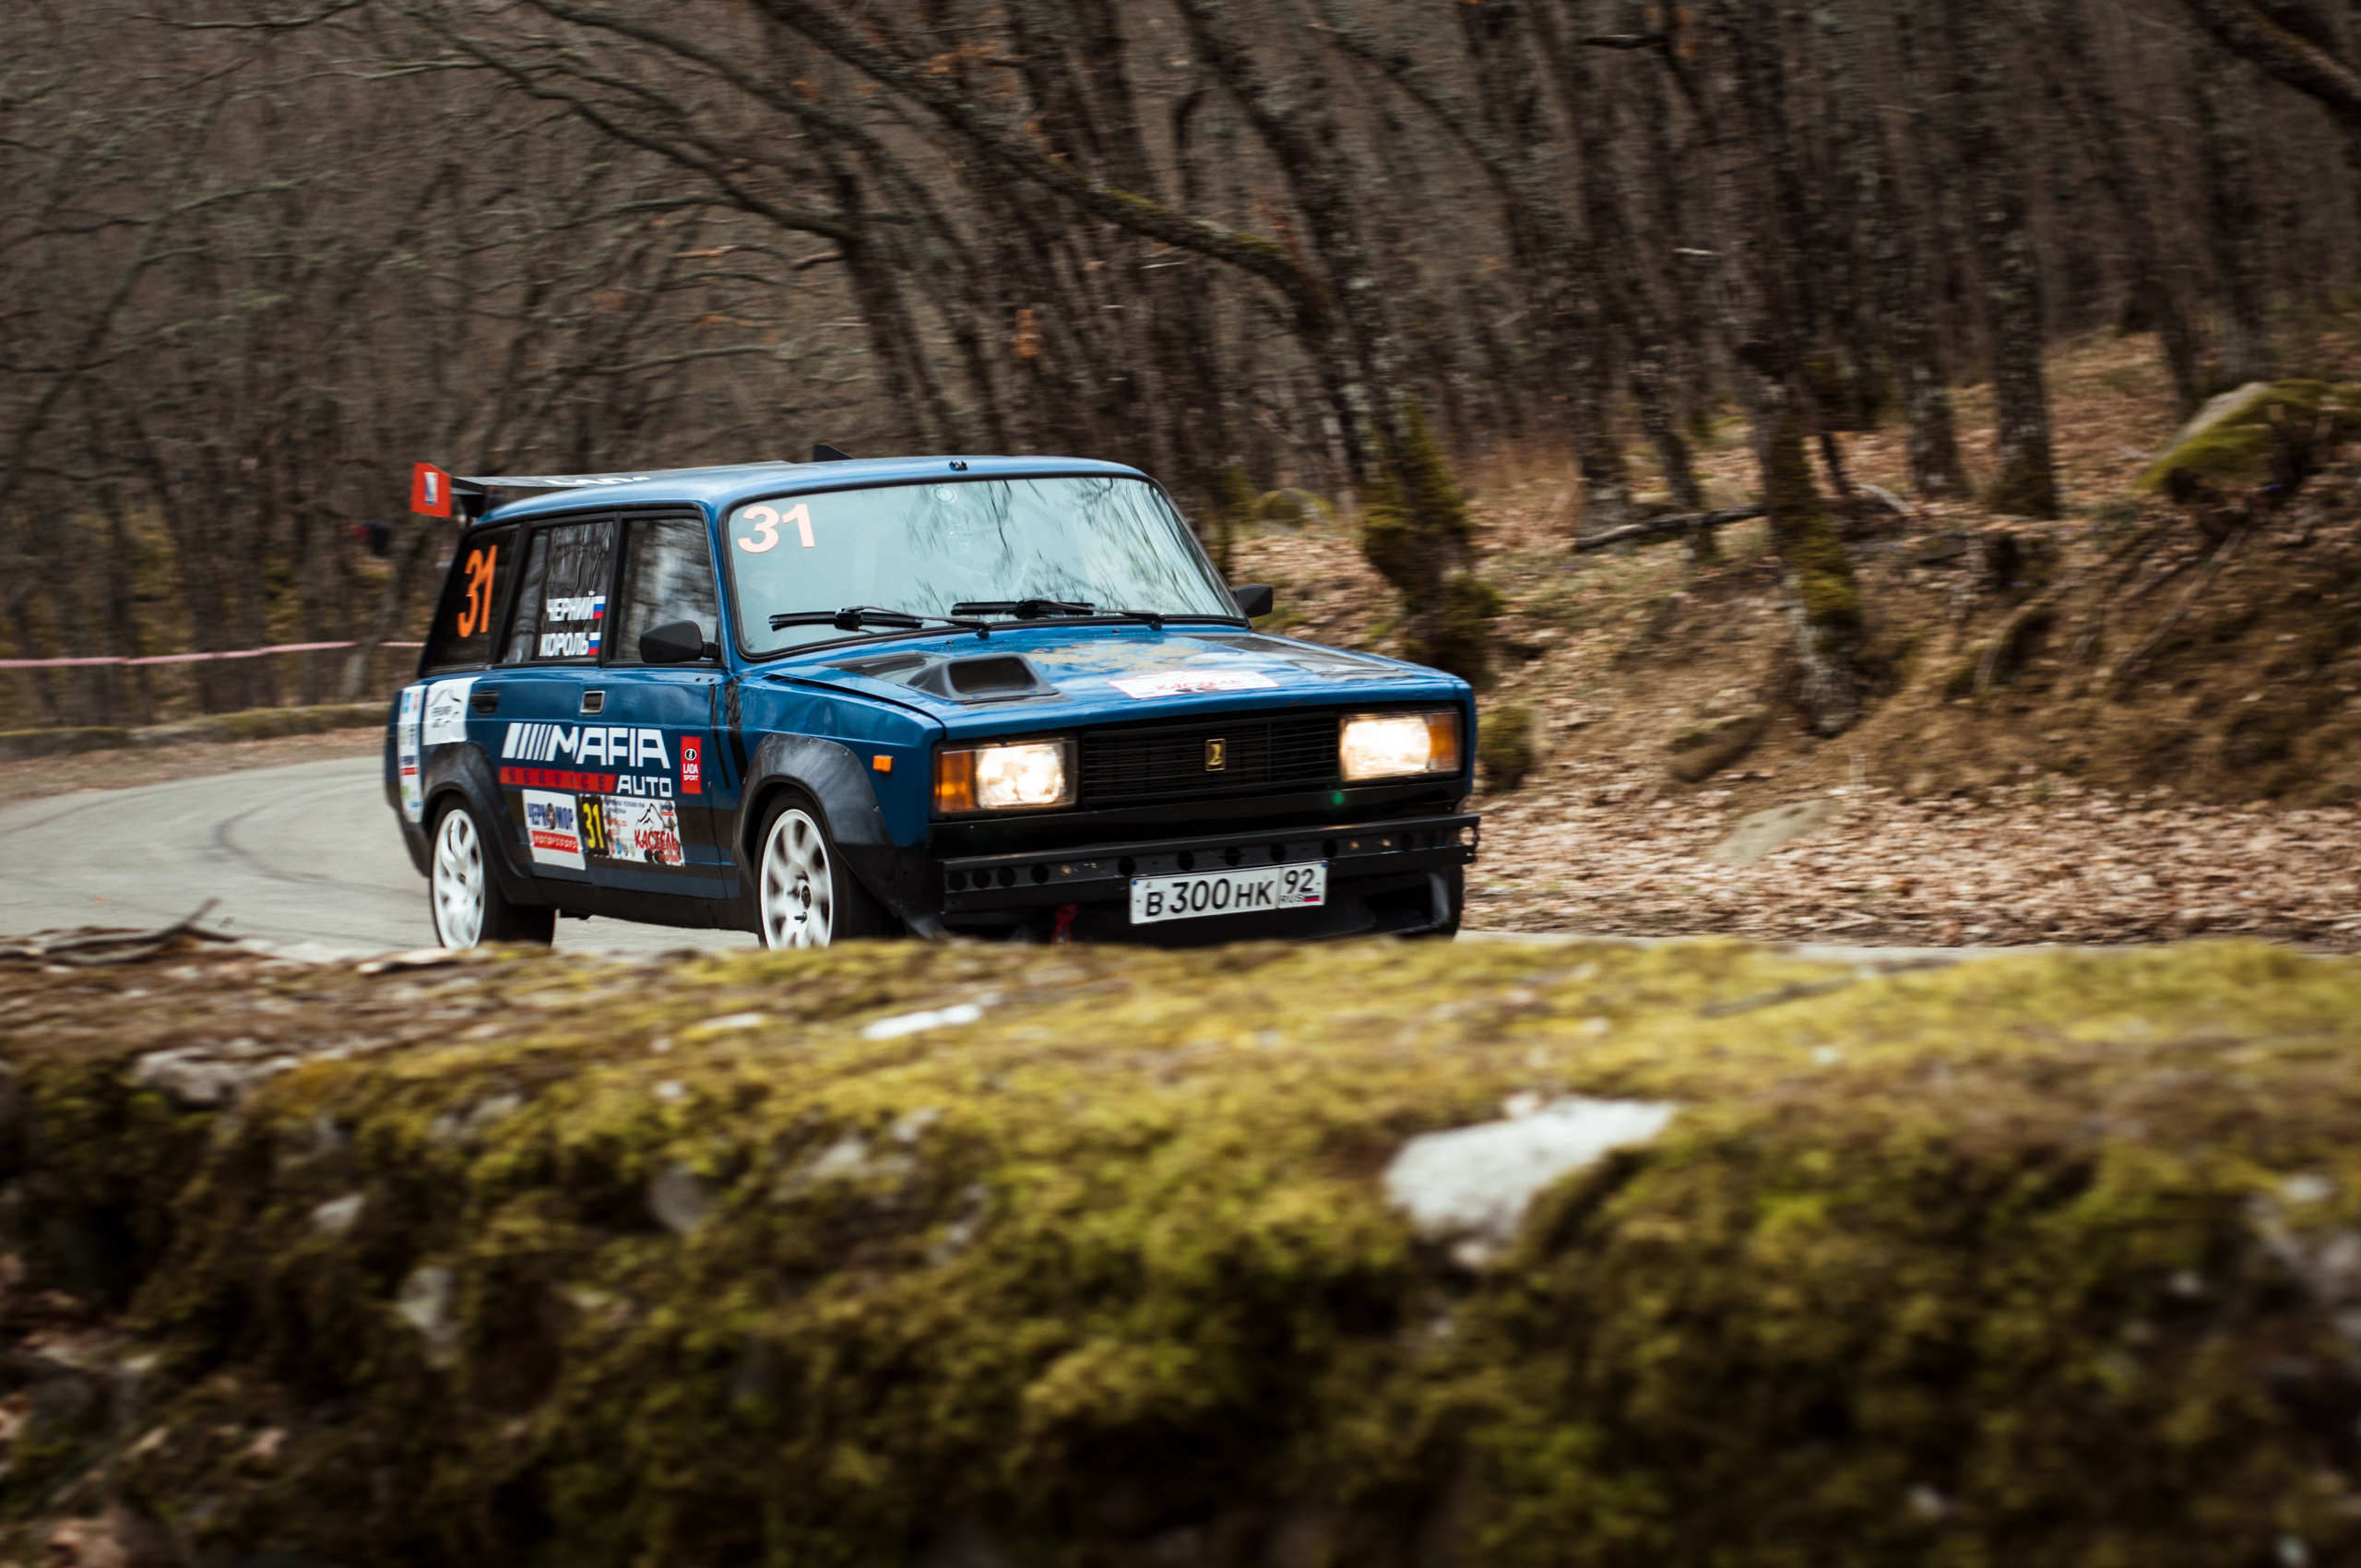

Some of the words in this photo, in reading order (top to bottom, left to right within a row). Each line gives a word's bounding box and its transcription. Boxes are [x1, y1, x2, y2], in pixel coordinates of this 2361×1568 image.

[738, 503, 815, 553] 31
[457, 544, 498, 638] 31
[539, 632, 589, 657] КОРОЛЬ
[544, 724, 671, 769] MAFIA
[508, 768, 606, 791] SERVICE
[682, 762, 699, 775] LADA
[616, 774, 672, 797] AUTO
[582, 802, 604, 849] 31
[635, 828, 679, 852] КАСТЕЛЬ
[1284, 868, 1314, 894] 92
[1279, 893, 1304, 904] RUS
